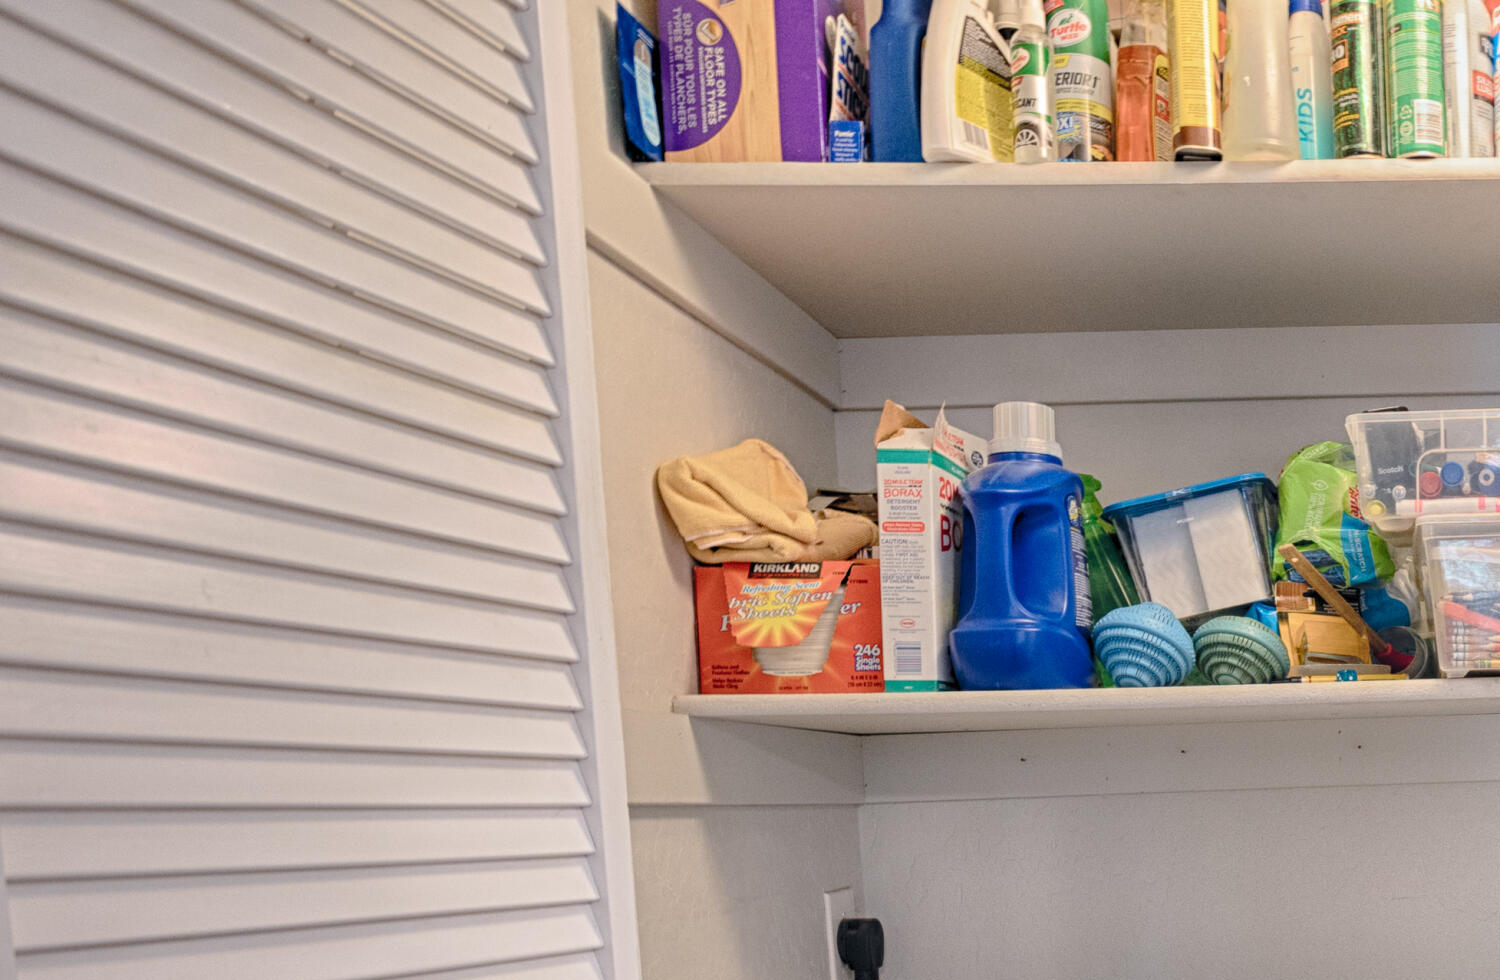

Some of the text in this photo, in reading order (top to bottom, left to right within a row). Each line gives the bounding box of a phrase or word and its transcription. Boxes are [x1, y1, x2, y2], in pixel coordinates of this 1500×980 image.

[672, 6, 683, 41] TYPES
[1050, 22, 1088, 38] Turtle
[673, 45, 684, 64] DE
[684, 39, 694, 71] POUR
[704, 47, 718, 126] FLOOR TYPES
[715, 47, 728, 122] SAFE ON ALL
[1055, 72, 1091, 87] ERIOR
[685, 73, 696, 105] TOUS
[688, 107, 697, 129] LES
[1297, 87, 1315, 143] KIDS
[1377, 464, 1405, 475] Scotch
[884, 488, 923, 498] BORAX
[939, 476, 953, 501] 20
[940, 514, 962, 552] BO
[753, 563, 820, 574] KIRKLAND
[742, 581, 821, 594] Refreshing Scent
[729, 597, 769, 610] bric
[734, 607, 796, 621] Sheets
[854, 644, 881, 656] 246
[855, 656, 880, 667] Single
[855, 663, 881, 672] Sheets
